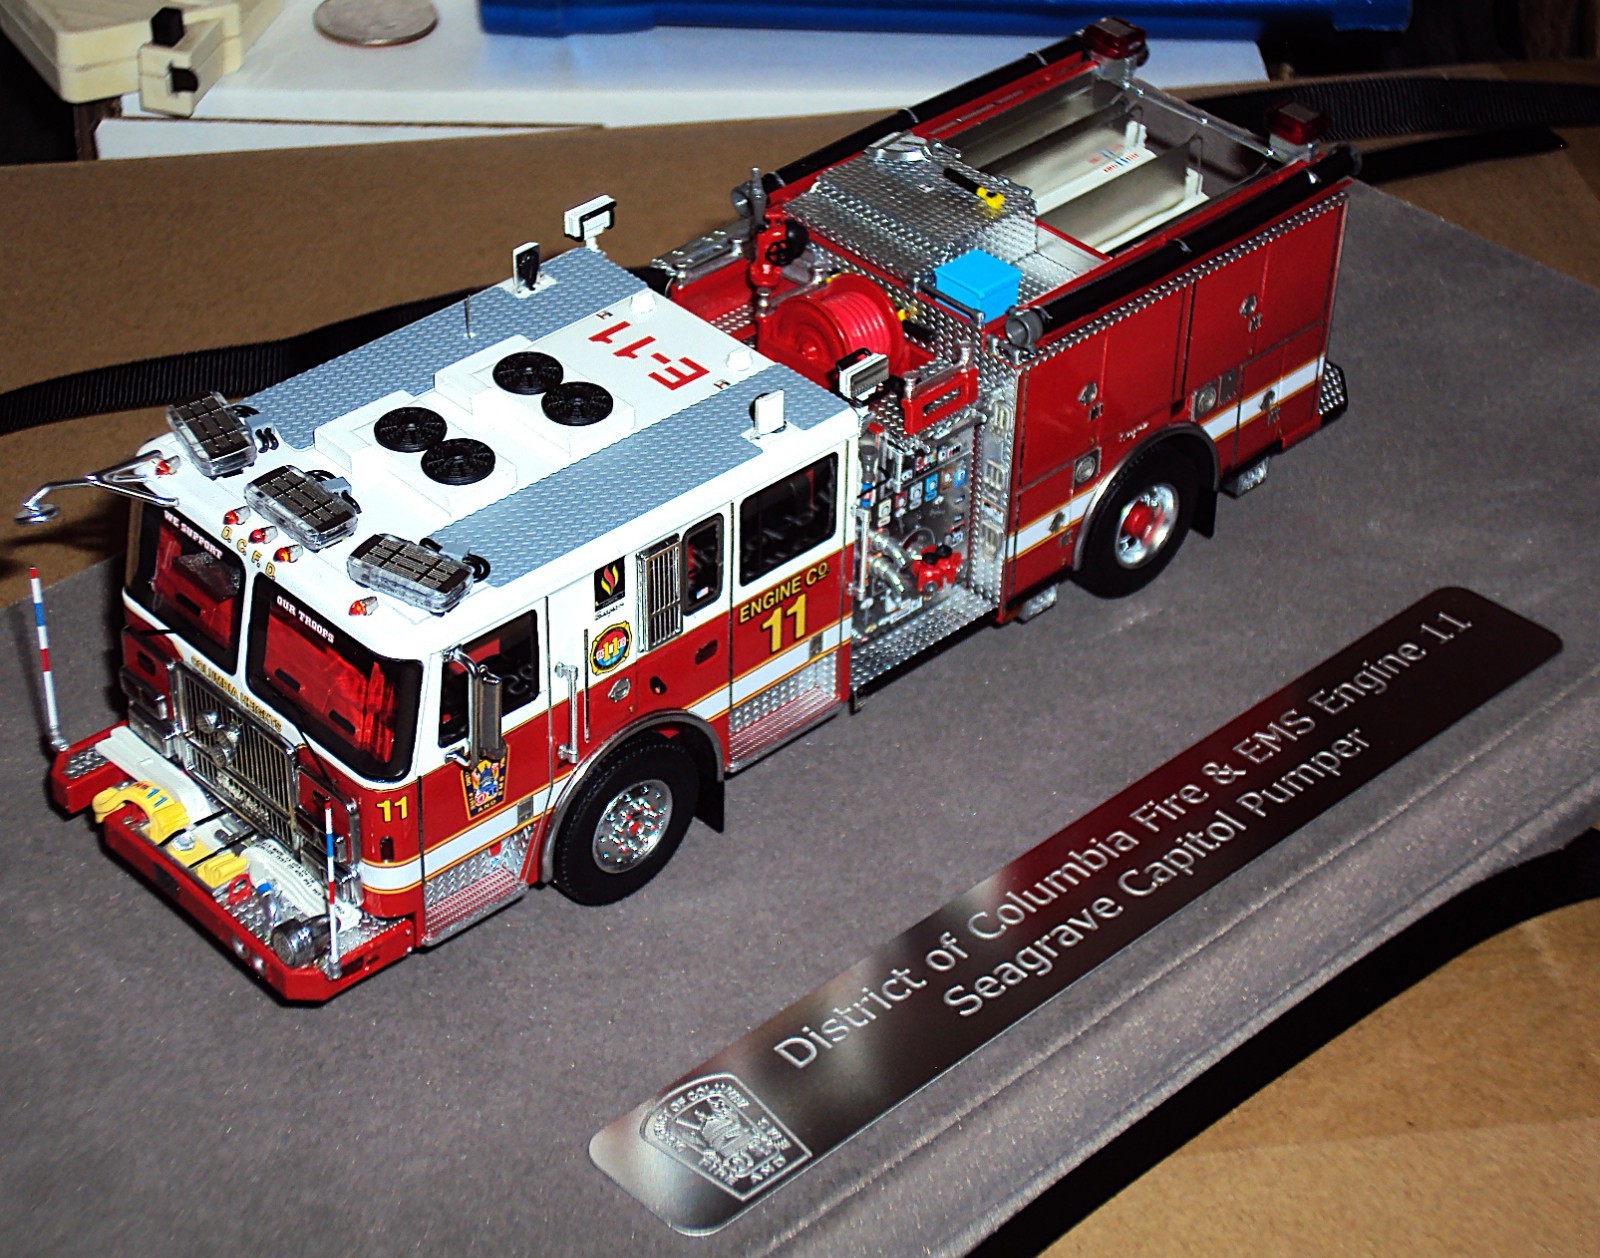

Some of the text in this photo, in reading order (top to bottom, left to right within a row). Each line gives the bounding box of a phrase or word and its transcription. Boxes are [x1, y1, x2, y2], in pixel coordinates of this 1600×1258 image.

[587, 320, 711, 391] E-11
[163, 509, 224, 561] WE SUPPORT
[276, 594, 335, 645] OUR TROOPS
[738, 574, 802, 625] ENGINE
[760, 592, 807, 655] 11
[375, 795, 409, 823] 11
[773, 611, 1473, 1069] District of Columbia Fire & EMS Engine 11
[943, 727, 1371, 1017] Seagrave Capitol Pumper
